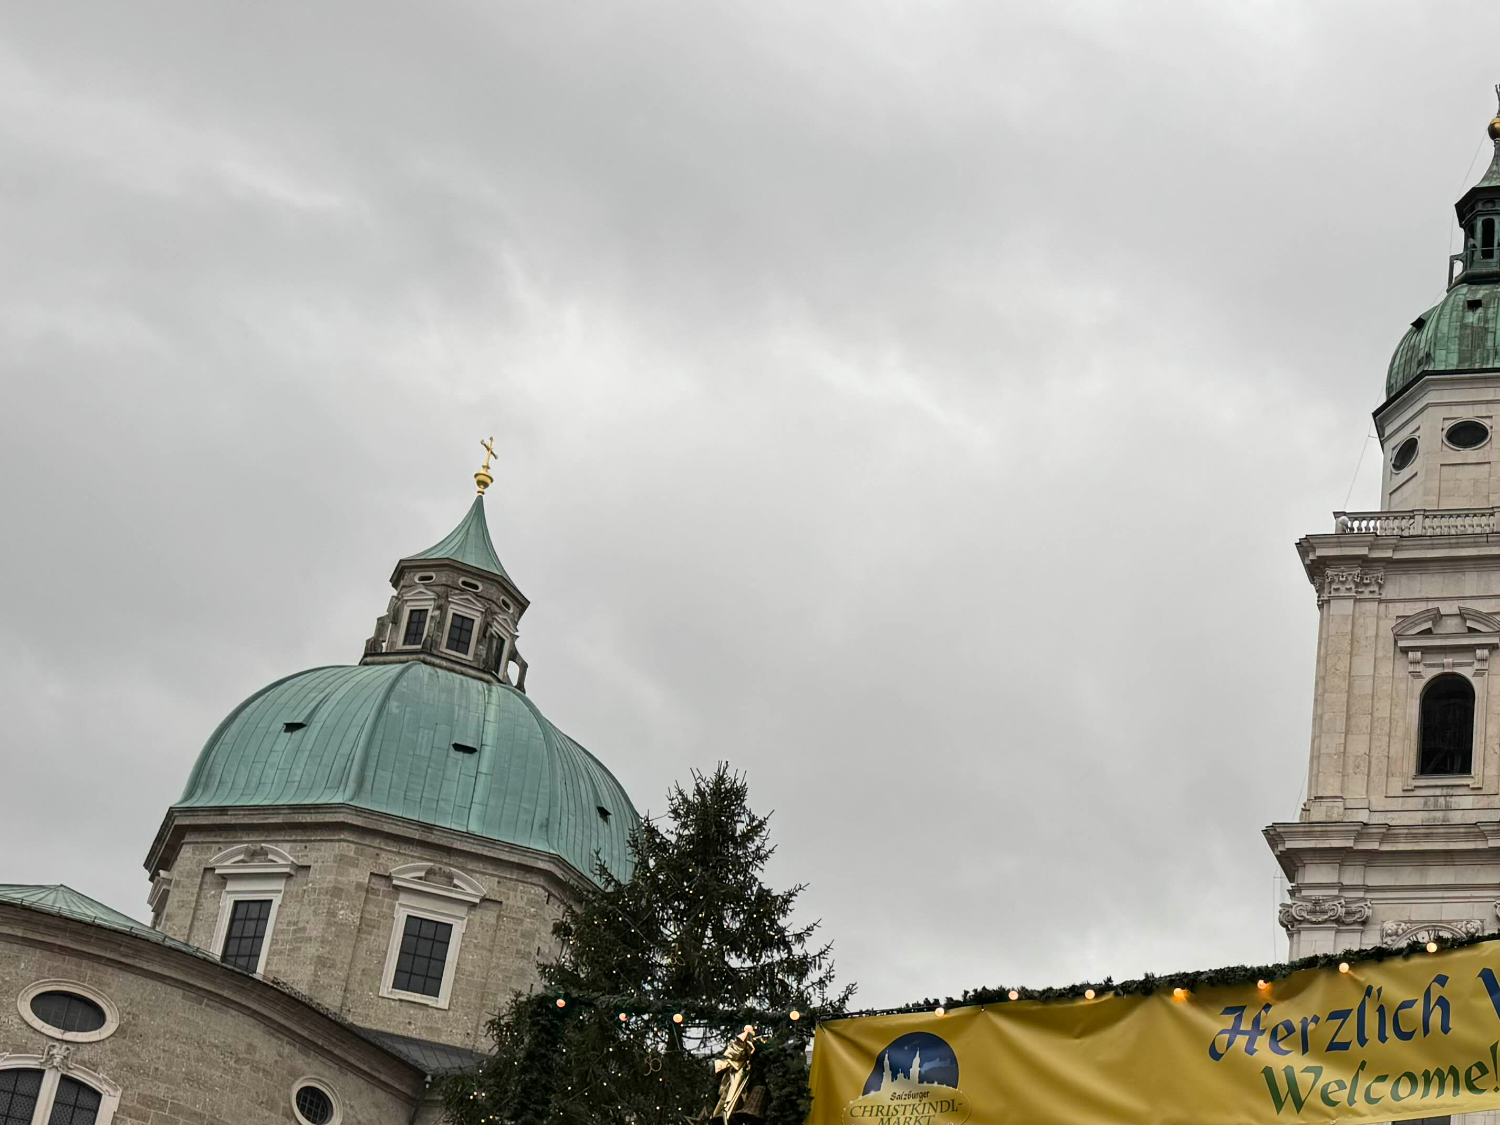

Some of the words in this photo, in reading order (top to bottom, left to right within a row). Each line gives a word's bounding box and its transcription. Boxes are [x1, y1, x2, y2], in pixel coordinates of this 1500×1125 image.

[1208, 972, 1452, 1062] Herzlich
[889, 1090, 931, 1103] Salzburger
[849, 1099, 964, 1118] CHRISTKINDL-
